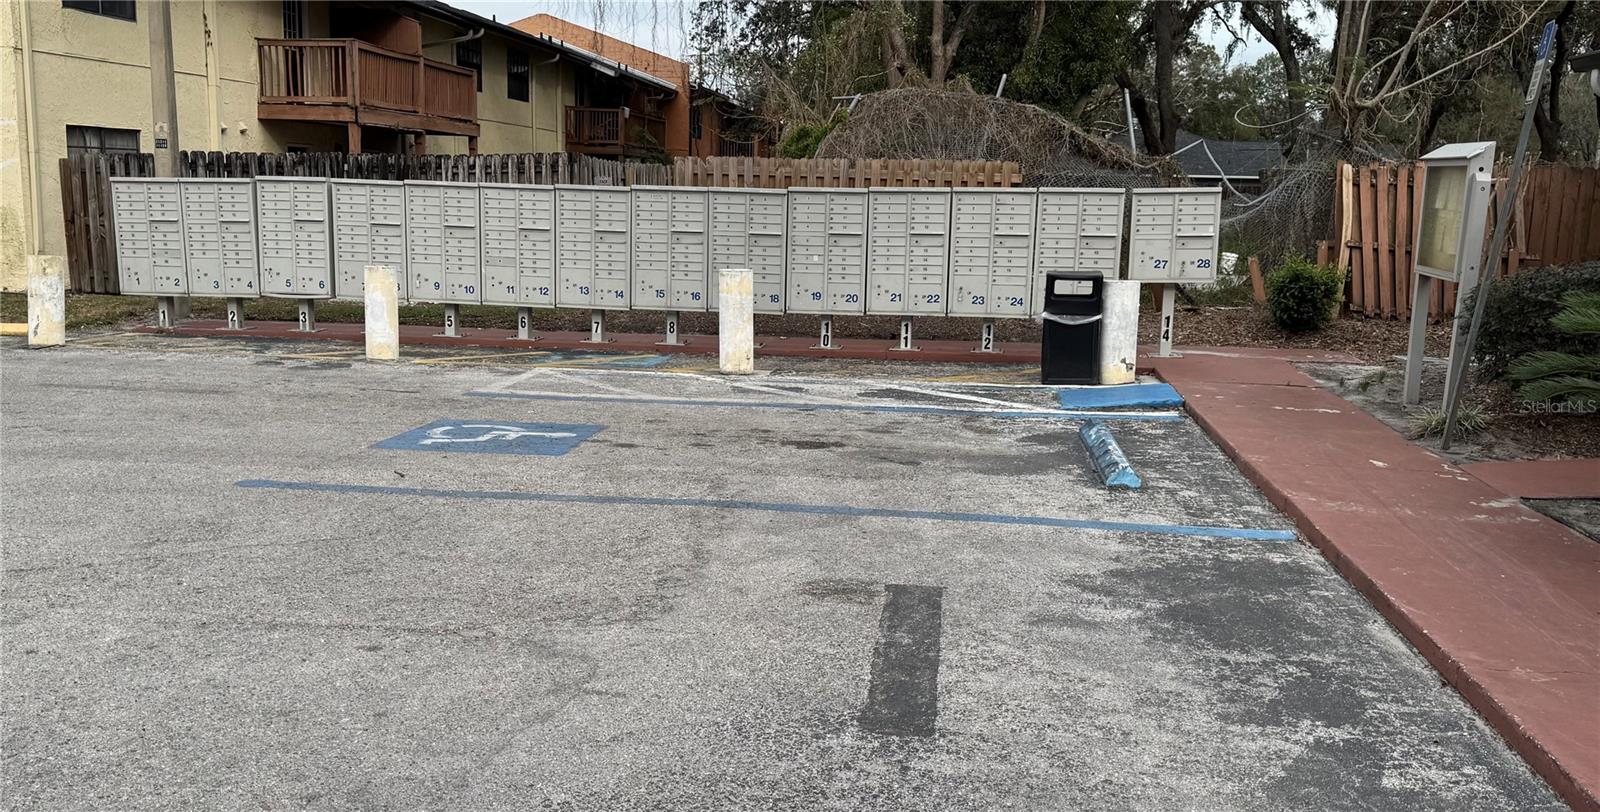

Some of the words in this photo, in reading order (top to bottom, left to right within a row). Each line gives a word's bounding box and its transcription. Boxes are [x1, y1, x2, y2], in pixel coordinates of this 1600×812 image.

[1154, 260, 1168, 269] 27
[1197, 259, 1210, 268] 28
[136, 277, 141, 286] 1
[173, 278, 180, 287] 2
[214, 281, 219, 289] 3
[247, 281, 253, 289] 4
[286, 279, 291, 287] 5
[319, 281, 325, 289] 6
[433, 282, 440, 291] 9
[464, 286, 474, 294] 10
[579, 287, 589, 295] 13
[538, 287, 549, 296] 12
[614, 290, 625, 299] 14
[655, 289, 665, 298] 15
[691, 292, 700, 300] 16
[811, 292, 821, 300] 19
[769, 295, 779, 304] 18
[846, 294, 858, 302] 20
[891, 293, 901, 302] 21
[927, 295, 940, 303] 22
[972, 296, 984, 304] 23
[1010, 296, 1024, 306] 24
[162, 310, 165, 321] 1
[230, 311, 236, 322] 2
[301, 312, 306, 324] 3
[447, 316, 452, 327] 5
[521, 316, 526, 328] 6
[594, 321, 599, 333] 7
[669, 321, 675, 333] 8
